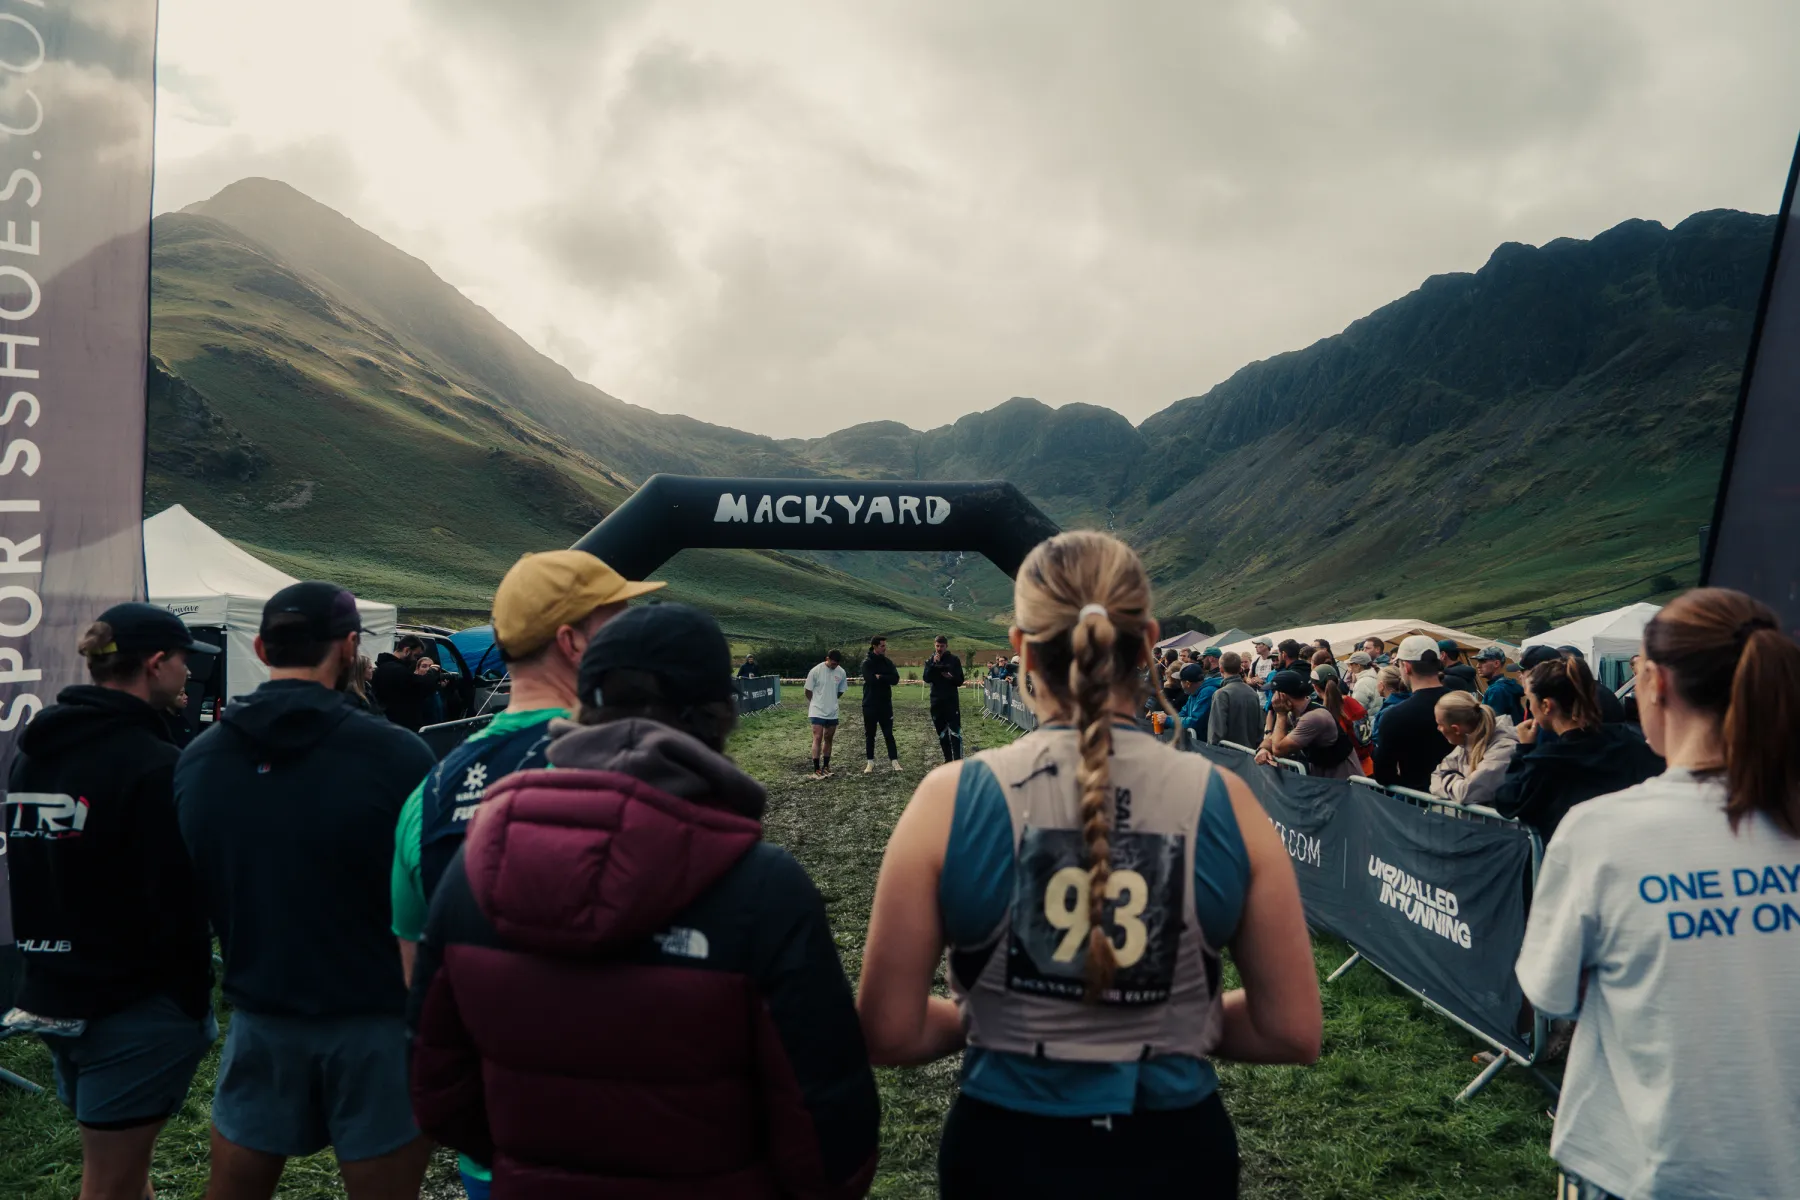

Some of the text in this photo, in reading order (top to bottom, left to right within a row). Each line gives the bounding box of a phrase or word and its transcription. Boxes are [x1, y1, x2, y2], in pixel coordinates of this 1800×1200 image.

[0, 0, 45, 732] SPORTSSHOES.CO
[714, 493, 951, 525] MACKYARD
[1639, 864, 1800, 904] ONE DAY
[1044, 866, 1149, 968] 93
[1668, 907, 1740, 939] DAY
[16, 940, 72, 952] HUUB
